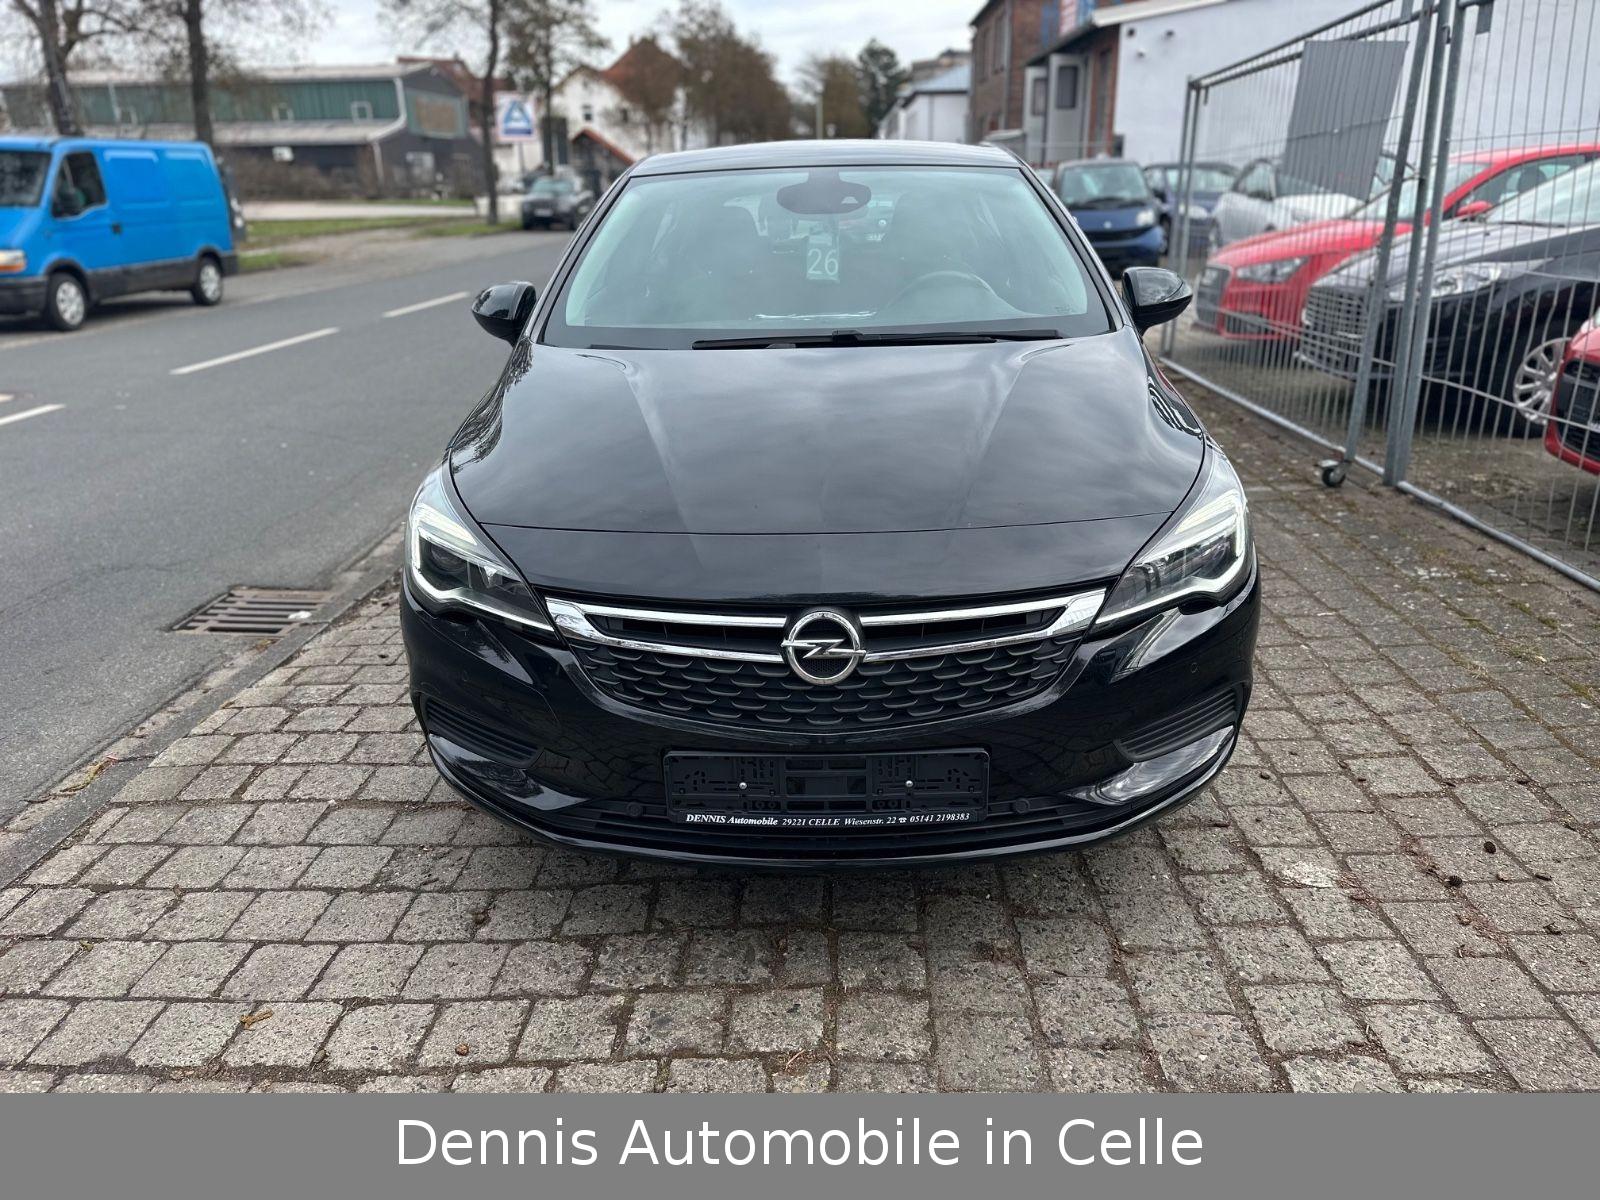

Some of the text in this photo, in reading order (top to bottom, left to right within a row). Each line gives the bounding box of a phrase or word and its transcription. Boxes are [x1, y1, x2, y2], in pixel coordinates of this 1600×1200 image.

[807, 247, 839, 276] 26
[686, 812, 970, 826] DENNIS Automobile 29221 CELLE Wiesenstr. 22 05141 2198383
